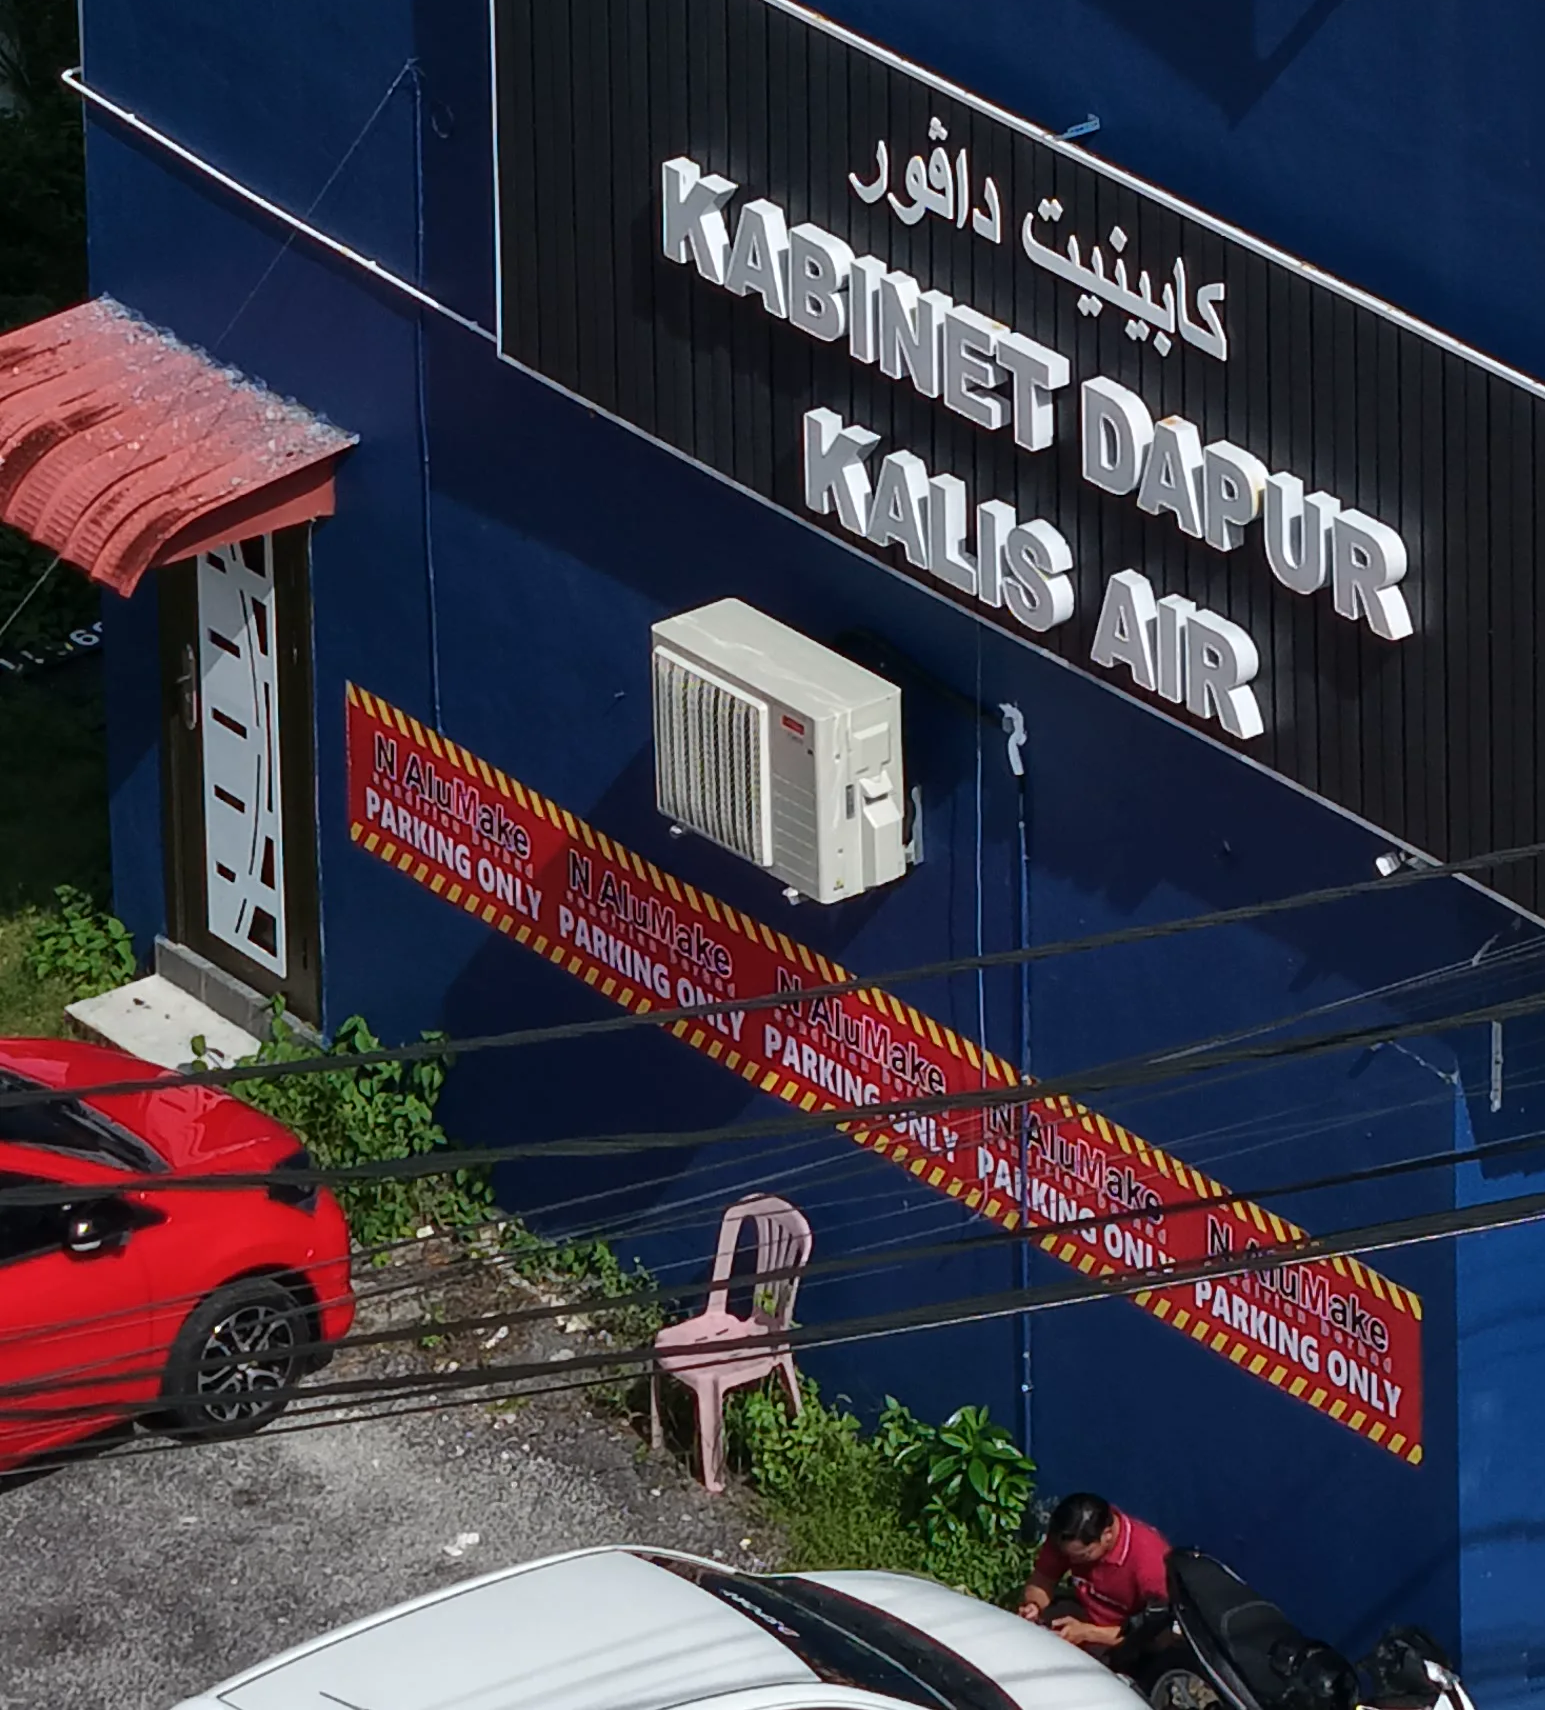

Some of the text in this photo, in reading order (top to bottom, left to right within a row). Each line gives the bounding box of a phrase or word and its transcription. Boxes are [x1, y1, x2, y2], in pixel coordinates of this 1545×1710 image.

[661, 156, 1413, 641] KABINET DAPUR
[803, 406, 1264, 740] KALIS AIR
[366, 786, 542, 921] PARKING ONLY
[374, 731, 532, 860] N AluMake
[559, 904, 745, 1042] PARKING ONLY
[569, 848, 733, 979] N AluMake
[764, 1023, 881, 1108] PARKING
[808, 995, 946, 1096] AluMake
[1026, 1111, 1164, 1225] AluMake
[1207, 1214, 1233, 1263] N
[1195, 1280, 1402, 1419] PARKING ONLY
